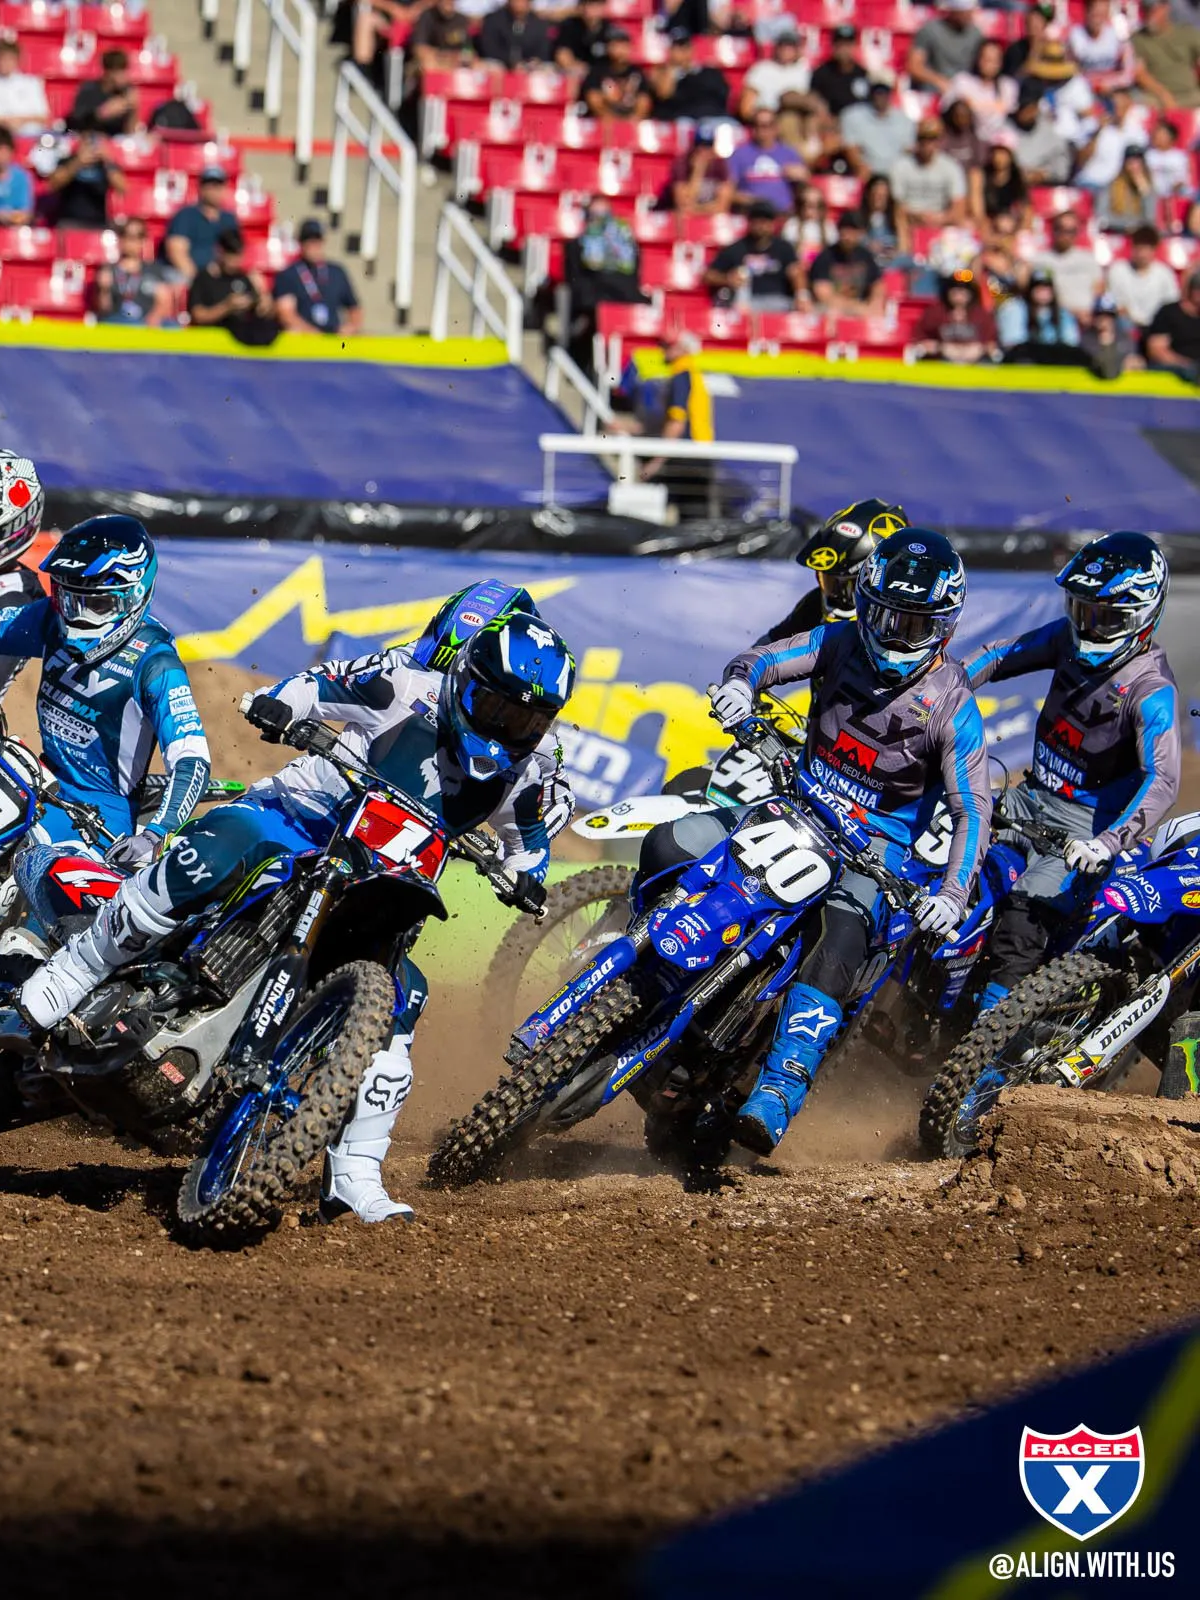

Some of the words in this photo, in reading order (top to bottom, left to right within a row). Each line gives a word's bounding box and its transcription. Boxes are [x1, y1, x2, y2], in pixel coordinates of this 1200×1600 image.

[50, 558, 87, 569] FLY
[1068, 574, 1103, 587] FLY
[888, 581, 927, 594] FLY
[463, 614, 481, 624] BELL
[44, 650, 119, 699] FLY
[39, 716, 92, 747] STUSSY
[40, 700, 94, 737] PAULSON
[712, 749, 774, 803] 34
[816, 745, 841, 771] TOYOTA
[841, 763, 885, 791] REDLANDS
[824, 769, 880, 809] YAMAHA
[467, 833, 487, 847] ARC
[731, 819, 832, 904] 40
[491, 873, 513, 893] ARC
[1118, 882, 1140, 914] YAMAHA
[255, 969, 291, 1039] DUNLOP
[550, 957, 615, 1025] DUNLOP
[1100, 989, 1162, 1051] DUNLOP
[613, 1062, 643, 1091] ACERBIS
